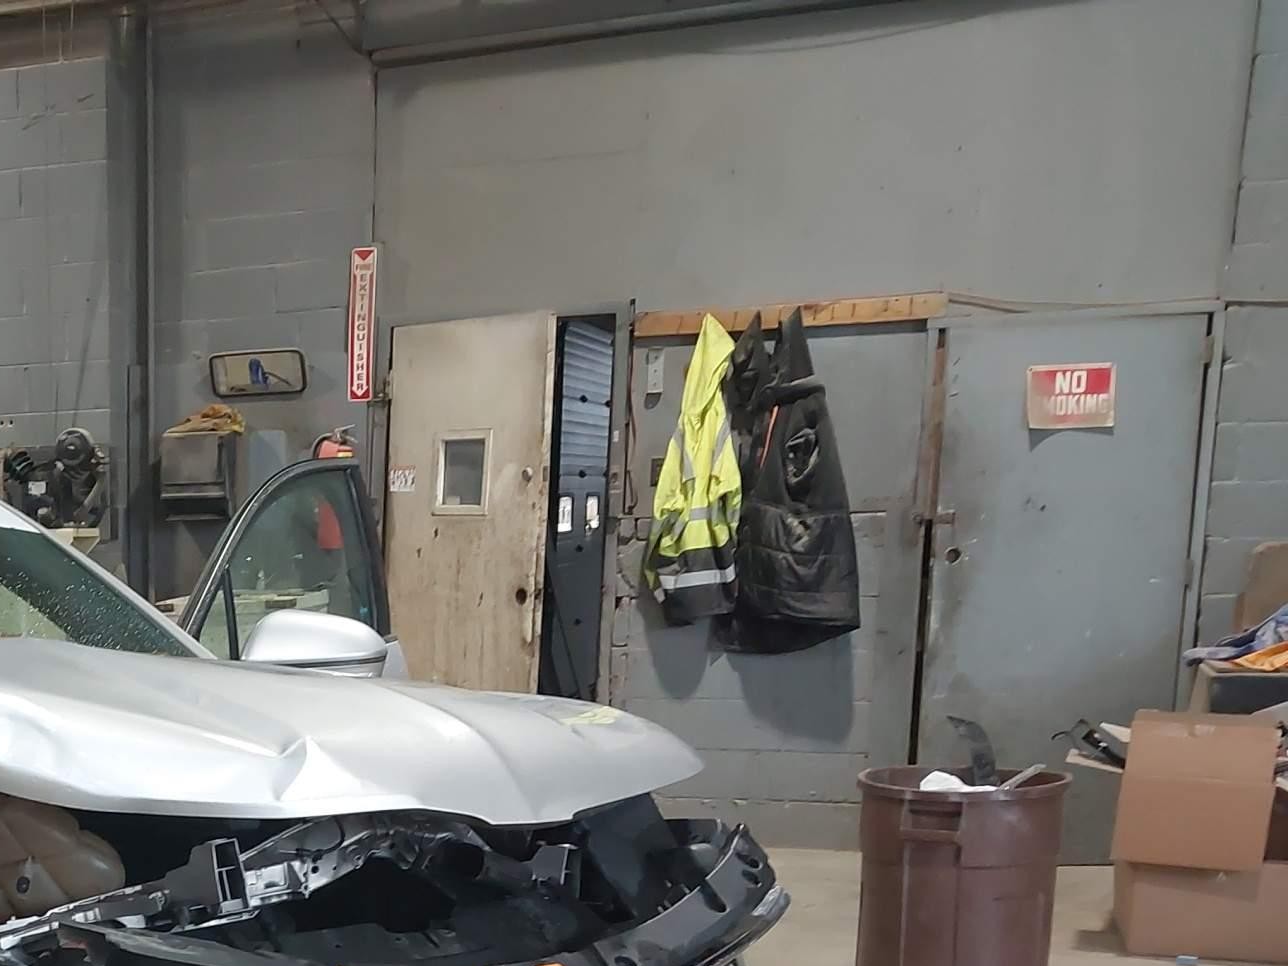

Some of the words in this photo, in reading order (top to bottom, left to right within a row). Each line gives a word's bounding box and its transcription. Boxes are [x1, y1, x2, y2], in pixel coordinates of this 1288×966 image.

[356, 273, 368, 391] EXTINGUISHER
[1055, 370, 1087, 394] NO
[1037, 393, 1110, 416] MOKING
